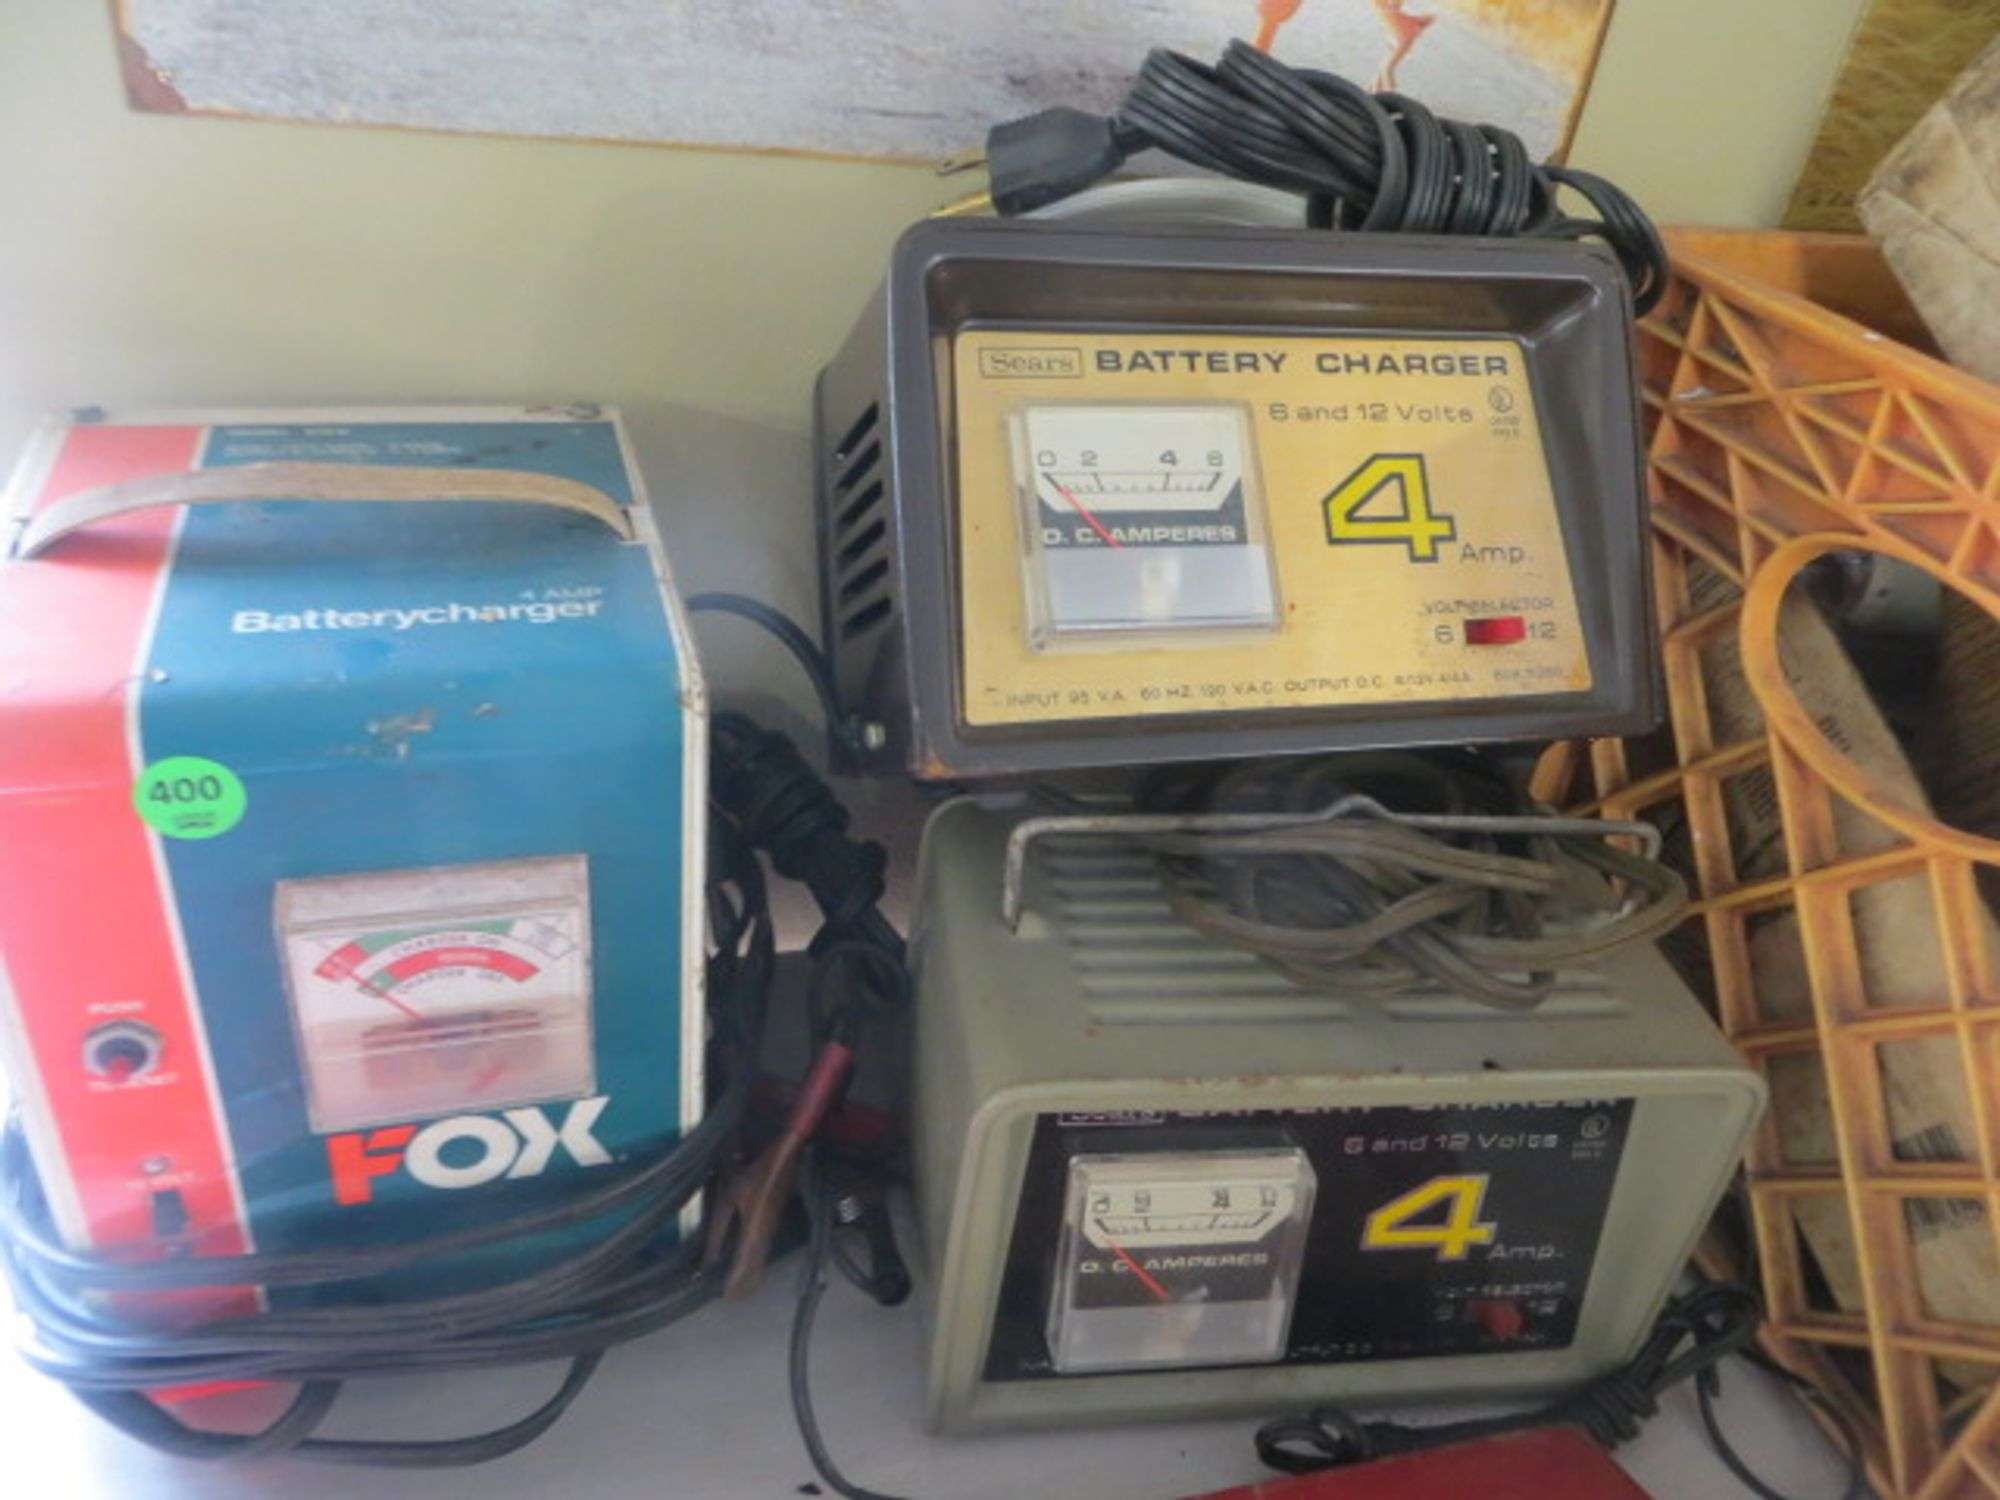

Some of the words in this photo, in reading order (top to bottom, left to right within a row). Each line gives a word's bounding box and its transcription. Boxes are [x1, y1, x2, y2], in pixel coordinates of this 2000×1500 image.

[989, 351, 1075, 374] Sears
[1096, 350, 1288, 374] BATTERY
[1315, 353, 1508, 377] CHARGER
[1296, 403, 1349, 422] and
[1357, 403, 1389, 422] 12
[1396, 404, 1474, 424] Volts
[1159, 450, 1178, 467] 4
[1322, 453, 1457, 563] 4
[1109, 524, 1237, 544] AMPERES
[230, 599, 604, 635] Batterycharger
[1284, 675, 1350, 692] OUTPUT
[148, 774, 222, 804] 400
[326, 1096, 614, 1206] FOX
[1360, 1173, 1498, 1262] 4
[1144, 1252, 1270, 1271] AMPERES
